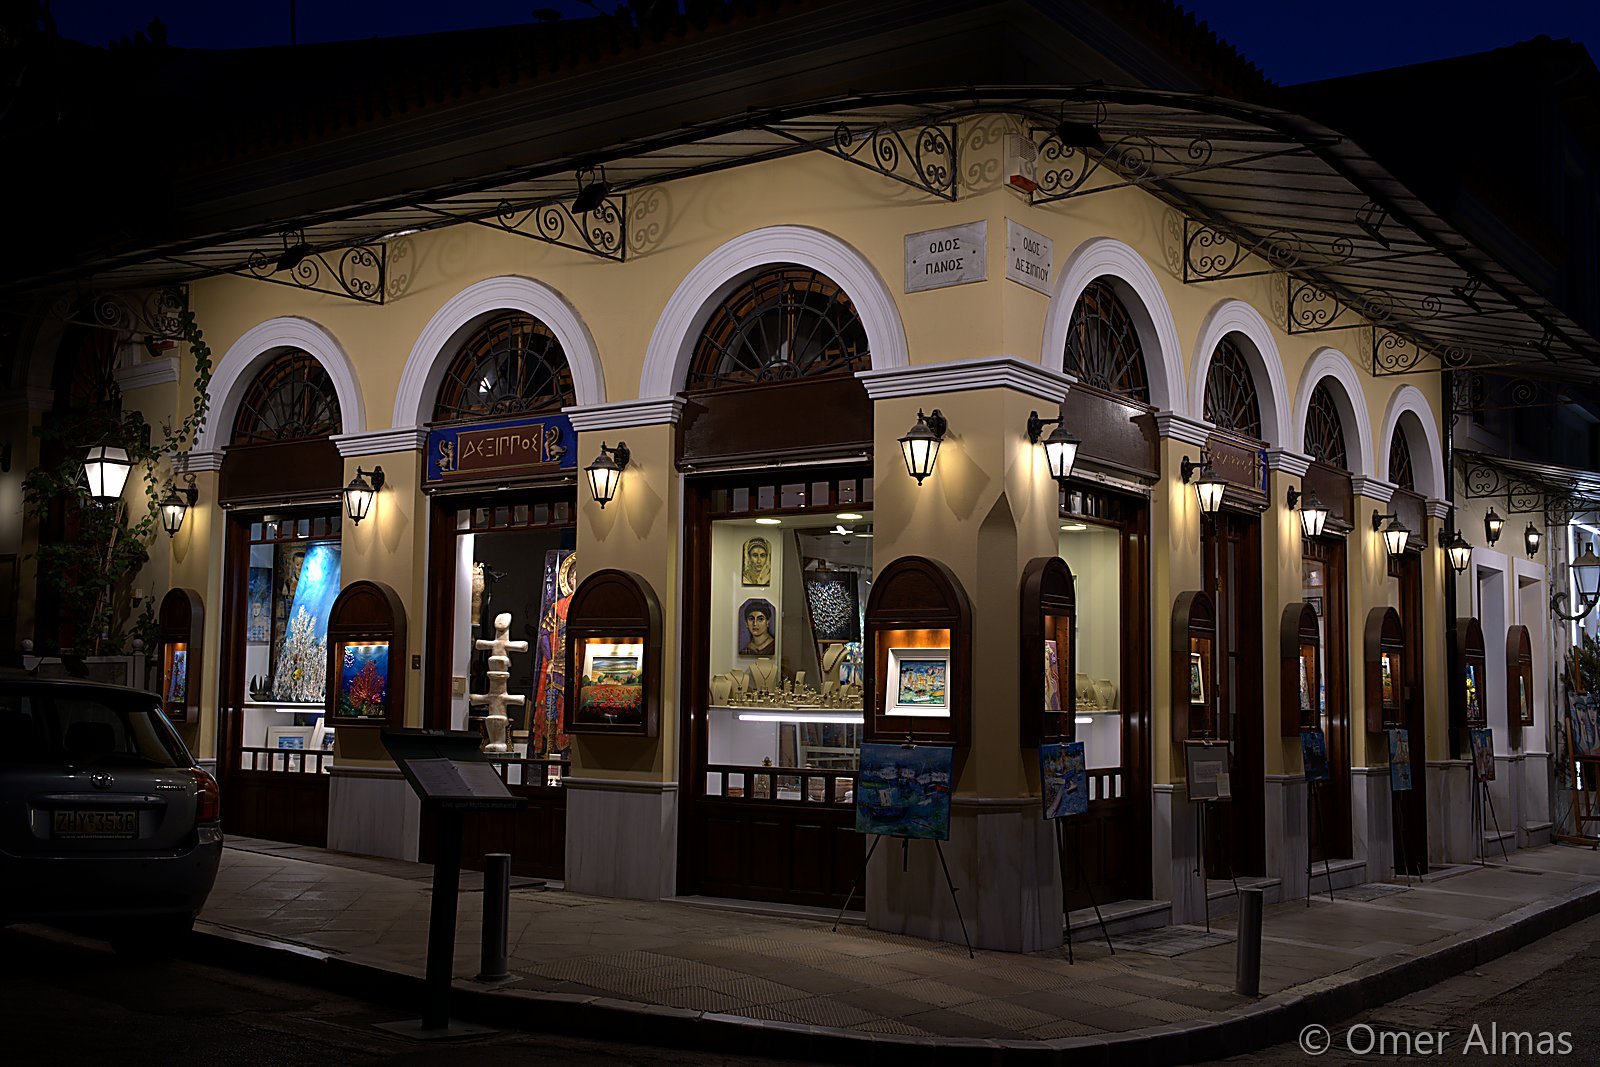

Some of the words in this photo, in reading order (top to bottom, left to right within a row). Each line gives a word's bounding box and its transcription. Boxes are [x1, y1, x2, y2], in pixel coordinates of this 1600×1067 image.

[929, 238, 961, 254] ΟΔΟΣ
[1023, 237, 1040, 256] ΟΔΟΣ
[925, 257, 964, 275] ΠΑΝΟΣ
[1015, 257, 1049, 282] ΔΕΞΙΠΠΟΥ
